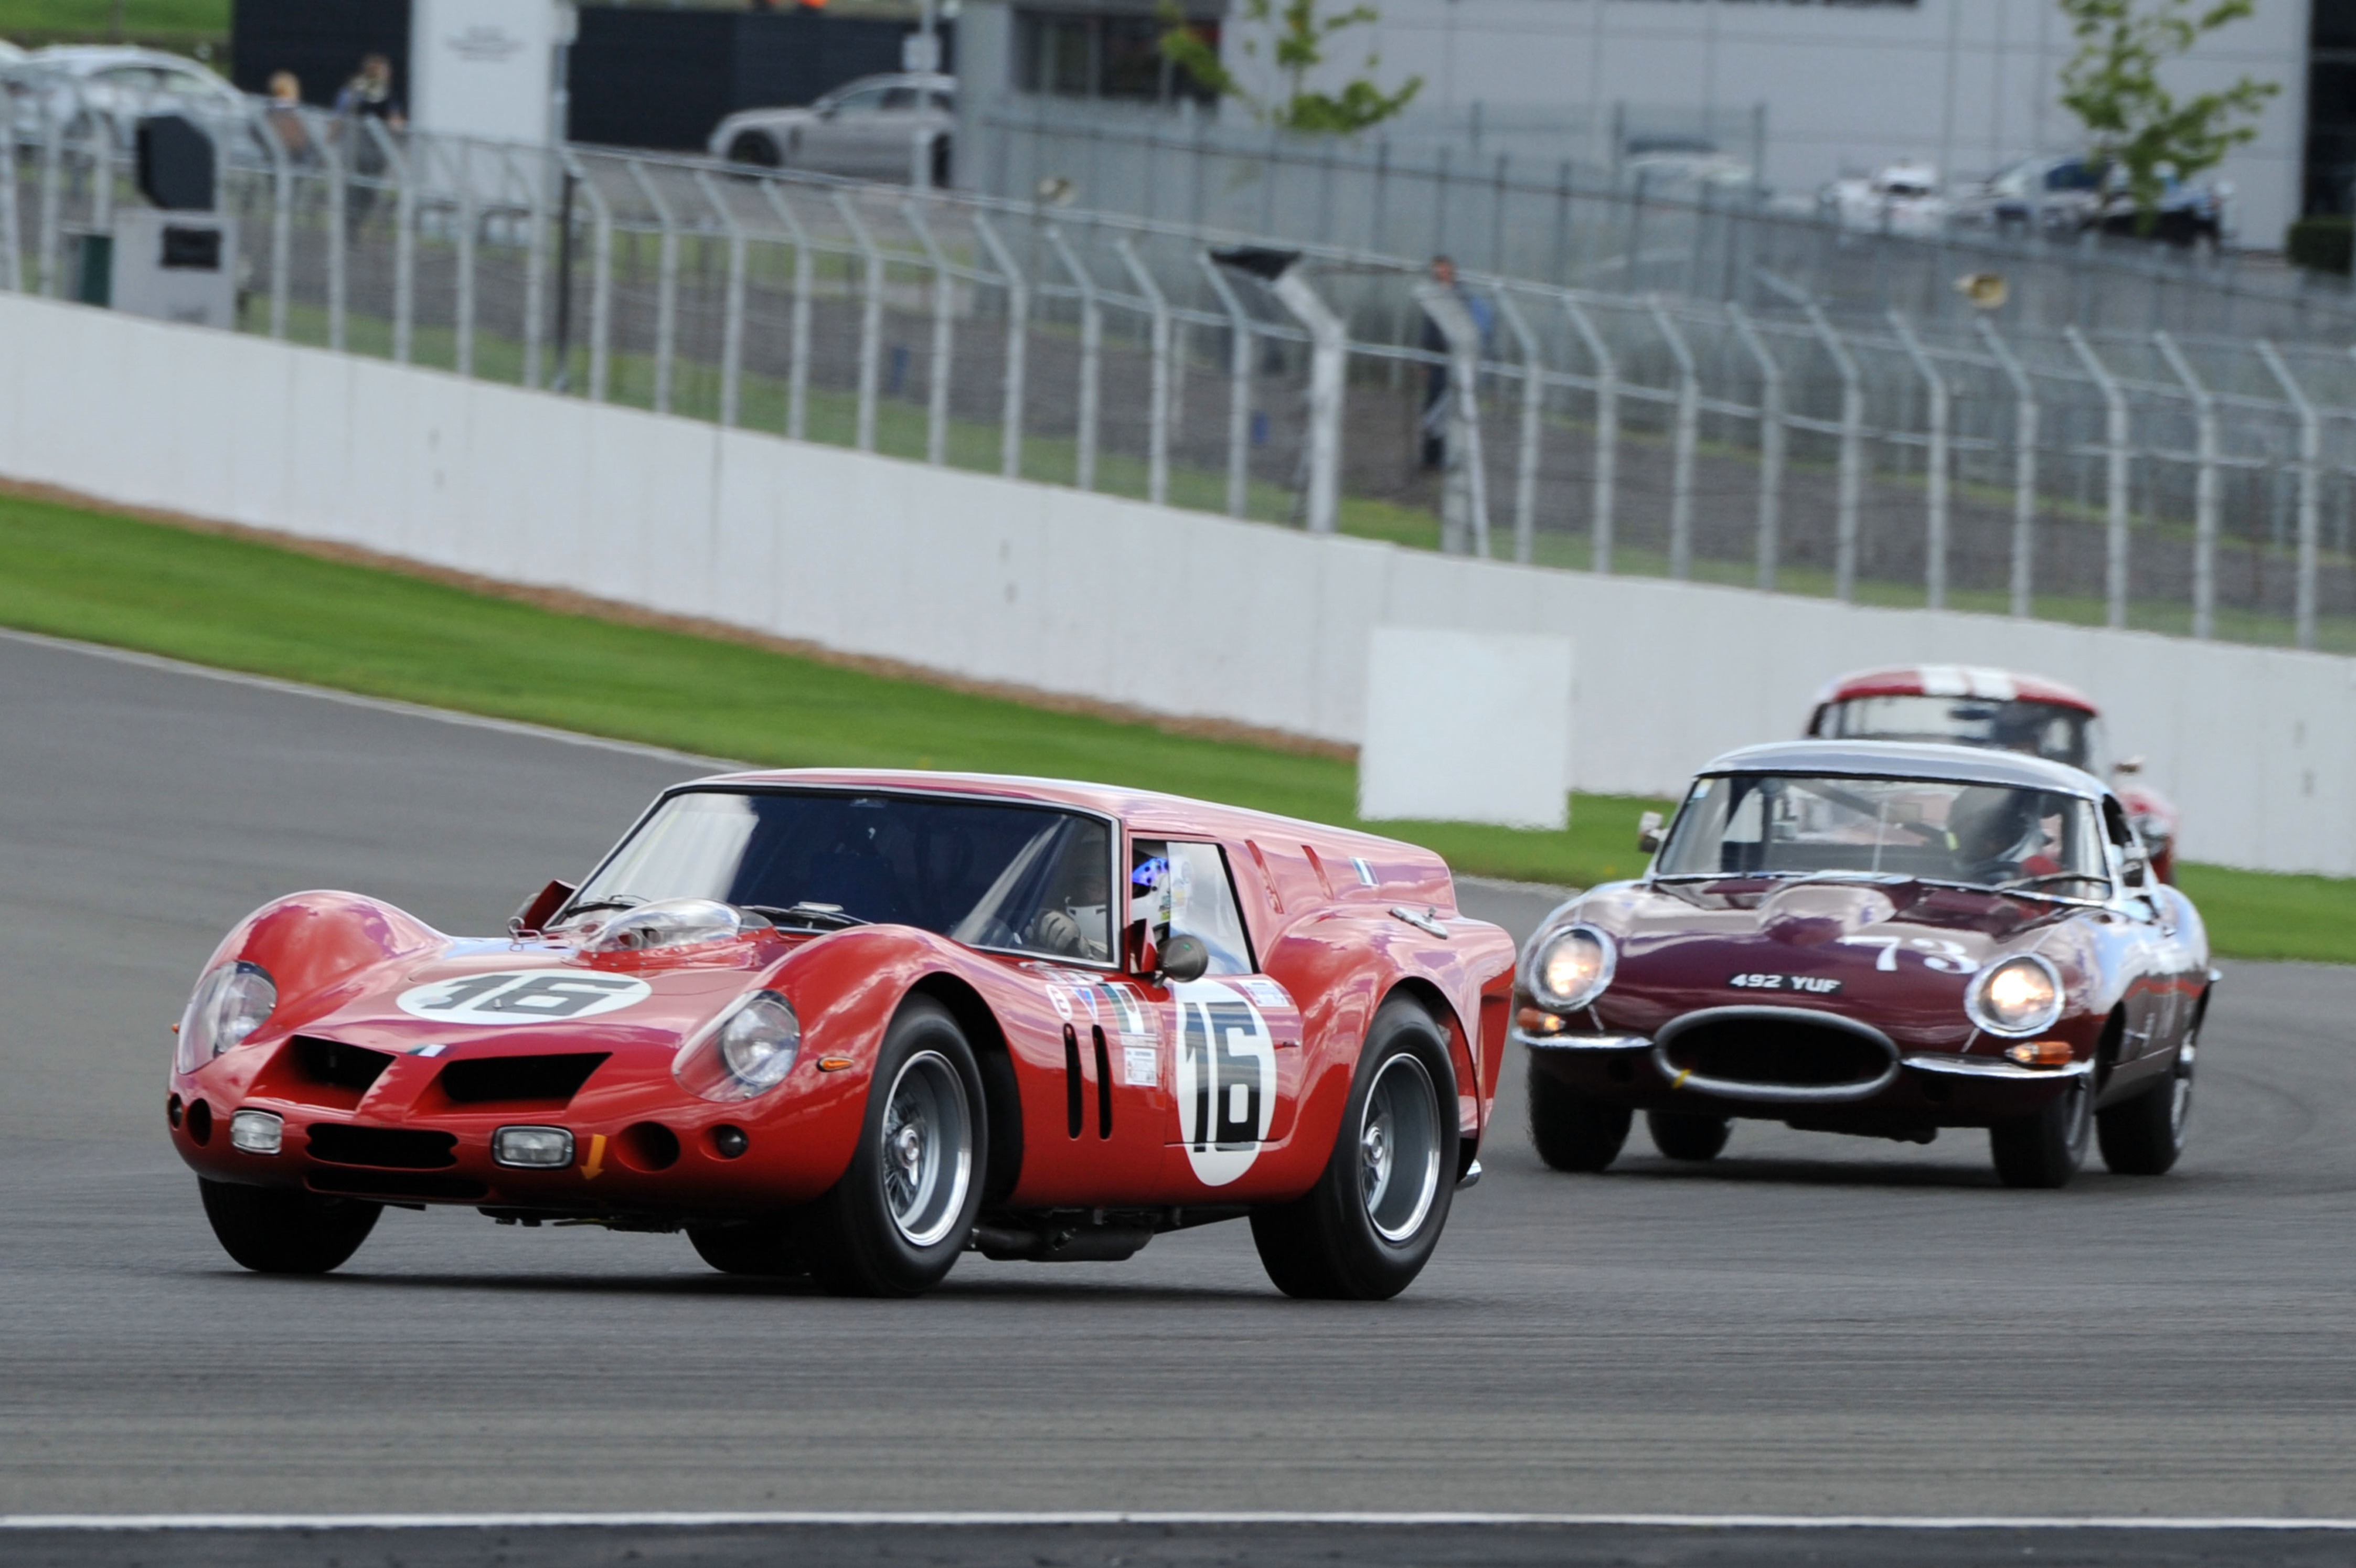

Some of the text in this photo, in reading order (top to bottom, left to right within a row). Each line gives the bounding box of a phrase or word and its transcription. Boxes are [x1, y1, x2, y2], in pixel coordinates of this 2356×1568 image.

[1836, 936, 1980, 974] 73
[420, 975, 640, 1017] 16
[1730, 974, 1841, 993] 492 YUF
[1182, 1001, 1260, 1153] 16
